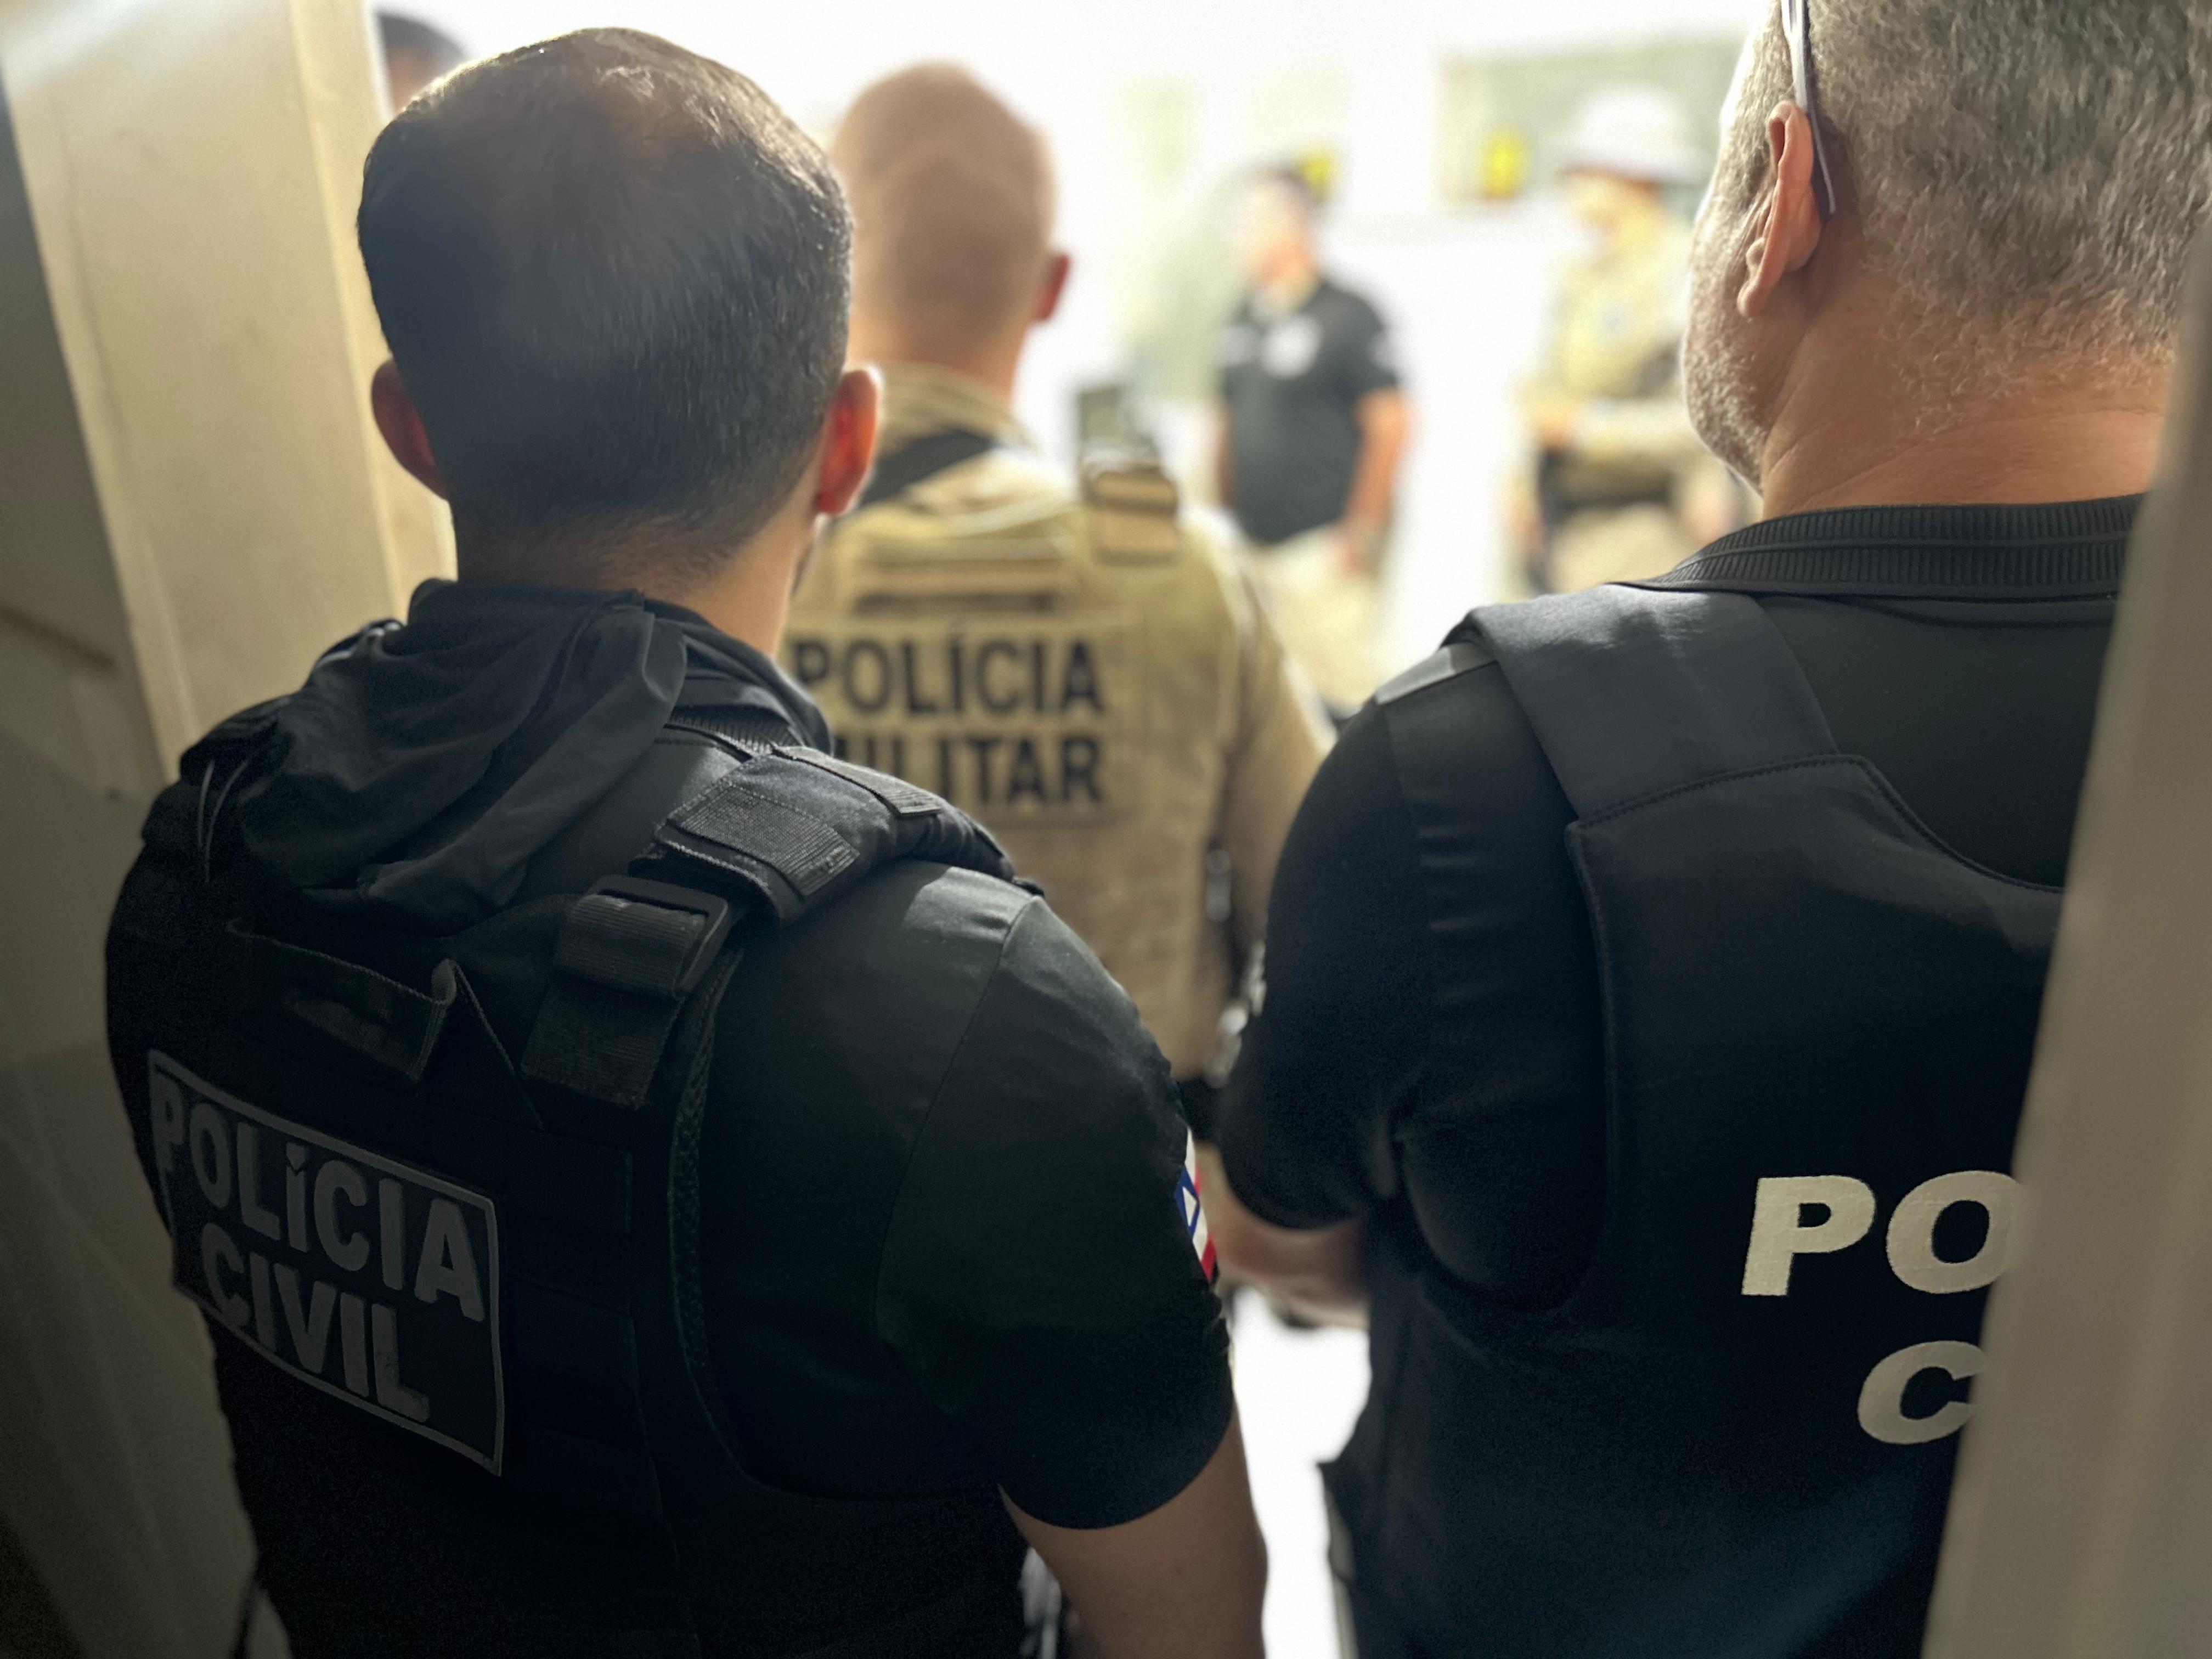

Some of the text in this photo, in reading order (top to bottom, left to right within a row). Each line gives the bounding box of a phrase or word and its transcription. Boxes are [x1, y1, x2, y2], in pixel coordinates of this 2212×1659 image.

[794, 625, 1104, 714] POLÍCIA
[151, 1074, 485, 1322] POLÍCIA
[201, 1223, 430, 1422] CIVIL
